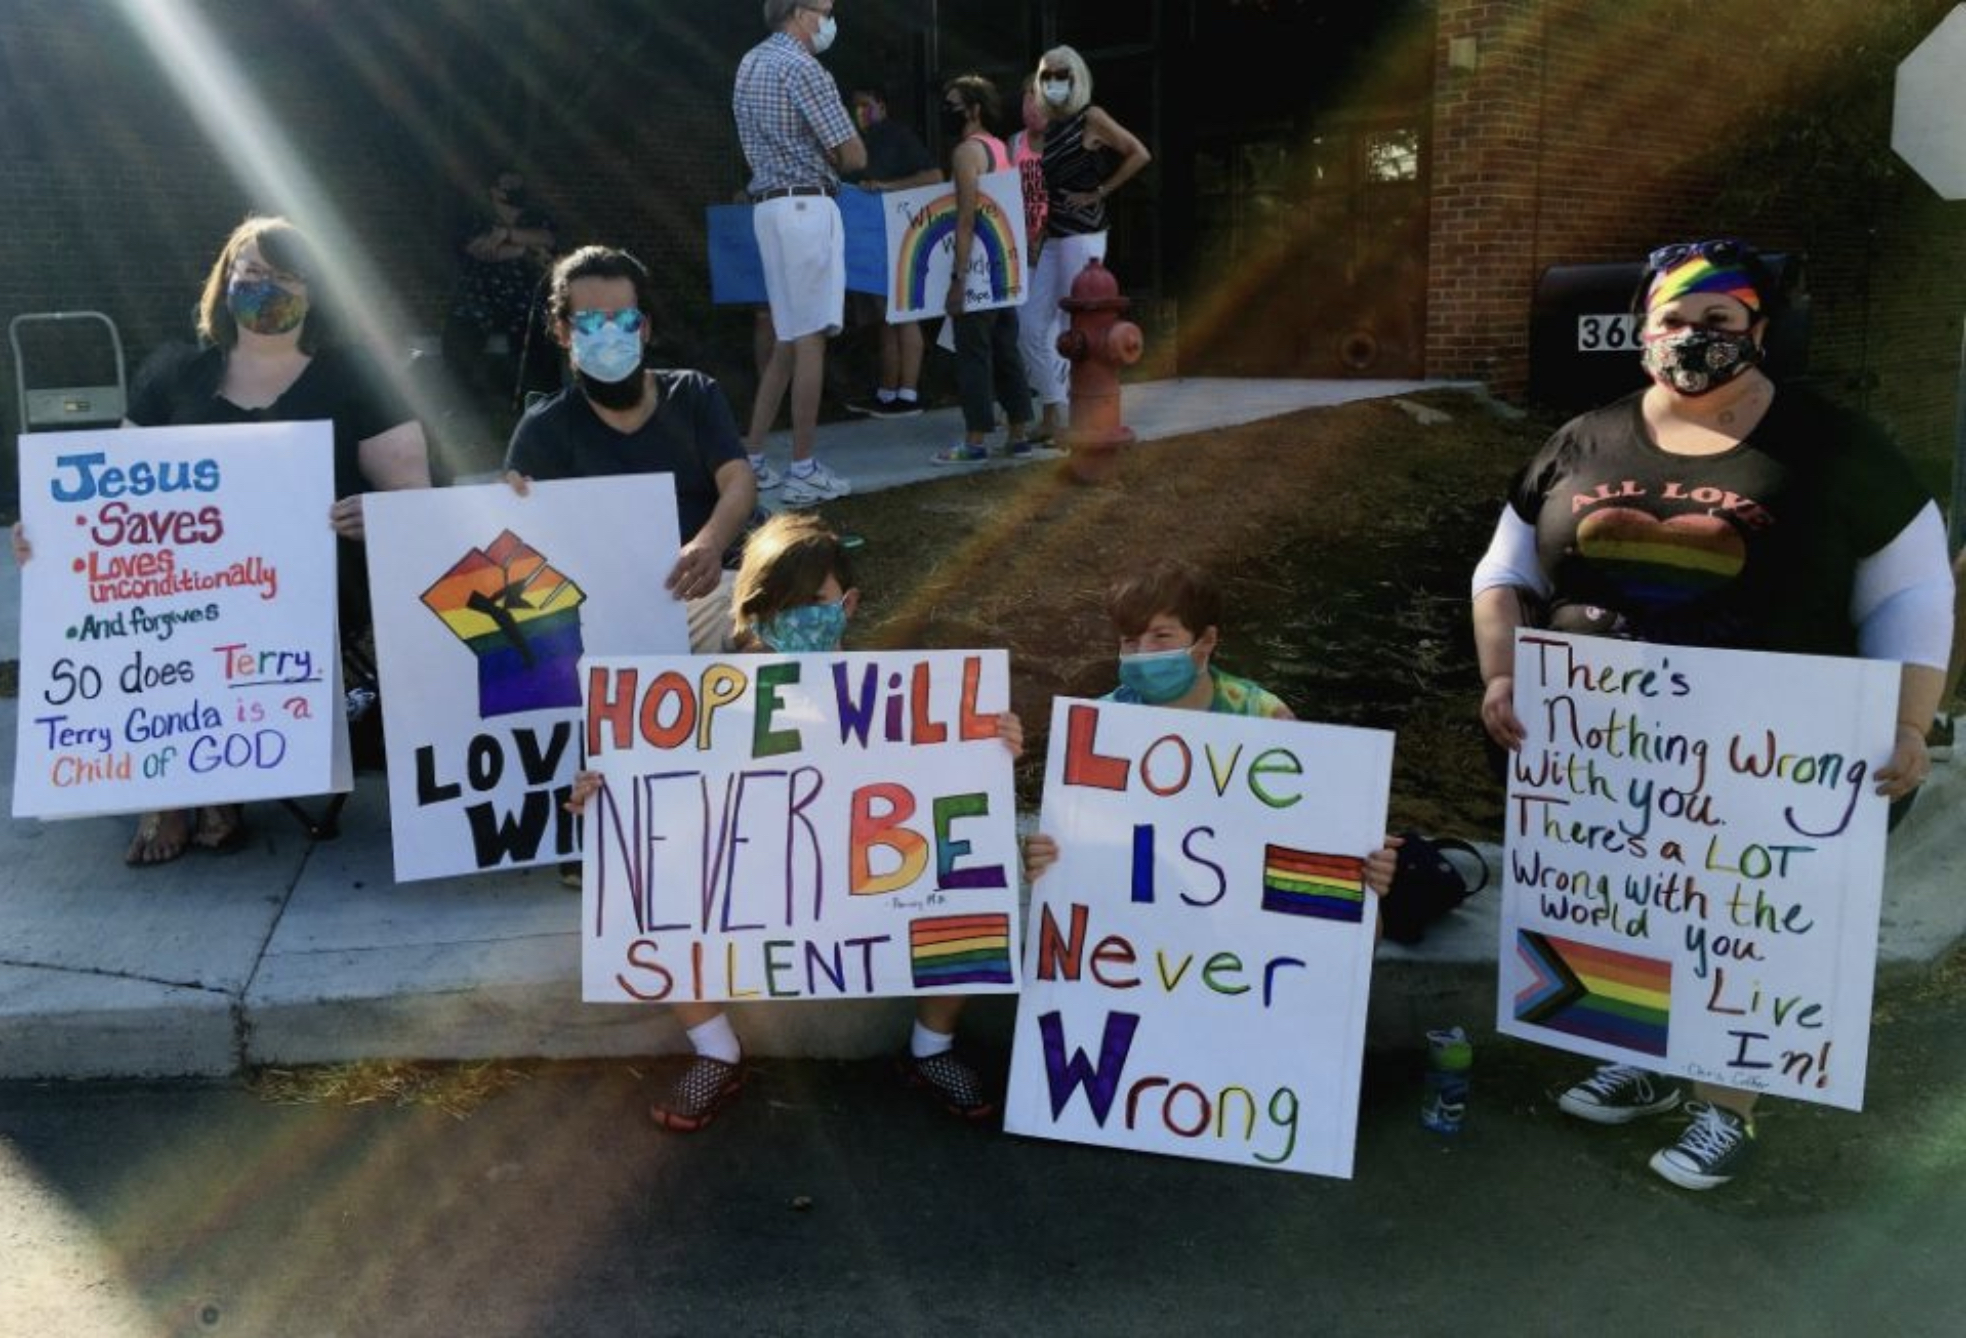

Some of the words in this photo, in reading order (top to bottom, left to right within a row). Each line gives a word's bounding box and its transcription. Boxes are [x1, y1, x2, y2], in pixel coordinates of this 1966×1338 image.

[51, 452, 220, 502] Jesus
[1572, 480, 1647, 514] ALL
[91, 502, 224, 546] Saves
[88, 549, 174, 582] Loves
[89, 556, 277, 603] unconditionally
[79, 613, 127, 641] And
[129, 603, 219, 641] forgives
[120, 651, 194, 693] does
[1518, 636, 1691, 697] There's
[35, 715, 112, 752] Terry
[125, 699, 222, 743] Gonda
[236, 698, 265, 722] is
[283, 696, 312, 720] a
[588, 661, 803, 759] HOPE
[51, 753, 132, 788] Child
[188, 729, 286, 773] GOD
[415, 721, 585, 806] LOV
[1063, 704, 1304, 809] Love
[465, 784, 584, 870] WI
[595, 766, 824, 937] NEVER
[849, 782, 1008, 893] BE
[1659, 841, 1686, 865] a
[1704, 834, 1818, 879] LOT
[1131, 823, 1227, 907] IS
[1512, 849, 1611, 901] Wrong
[1726, 883, 1815, 934] the
[616, 935, 891, 1001] SILENT
[1036, 902, 1307, 1008] Never
[1705, 966, 1824, 1030] Live
[1038, 1009, 1299, 1164] Wrong
[1726, 1029, 1833, 1090] In!
